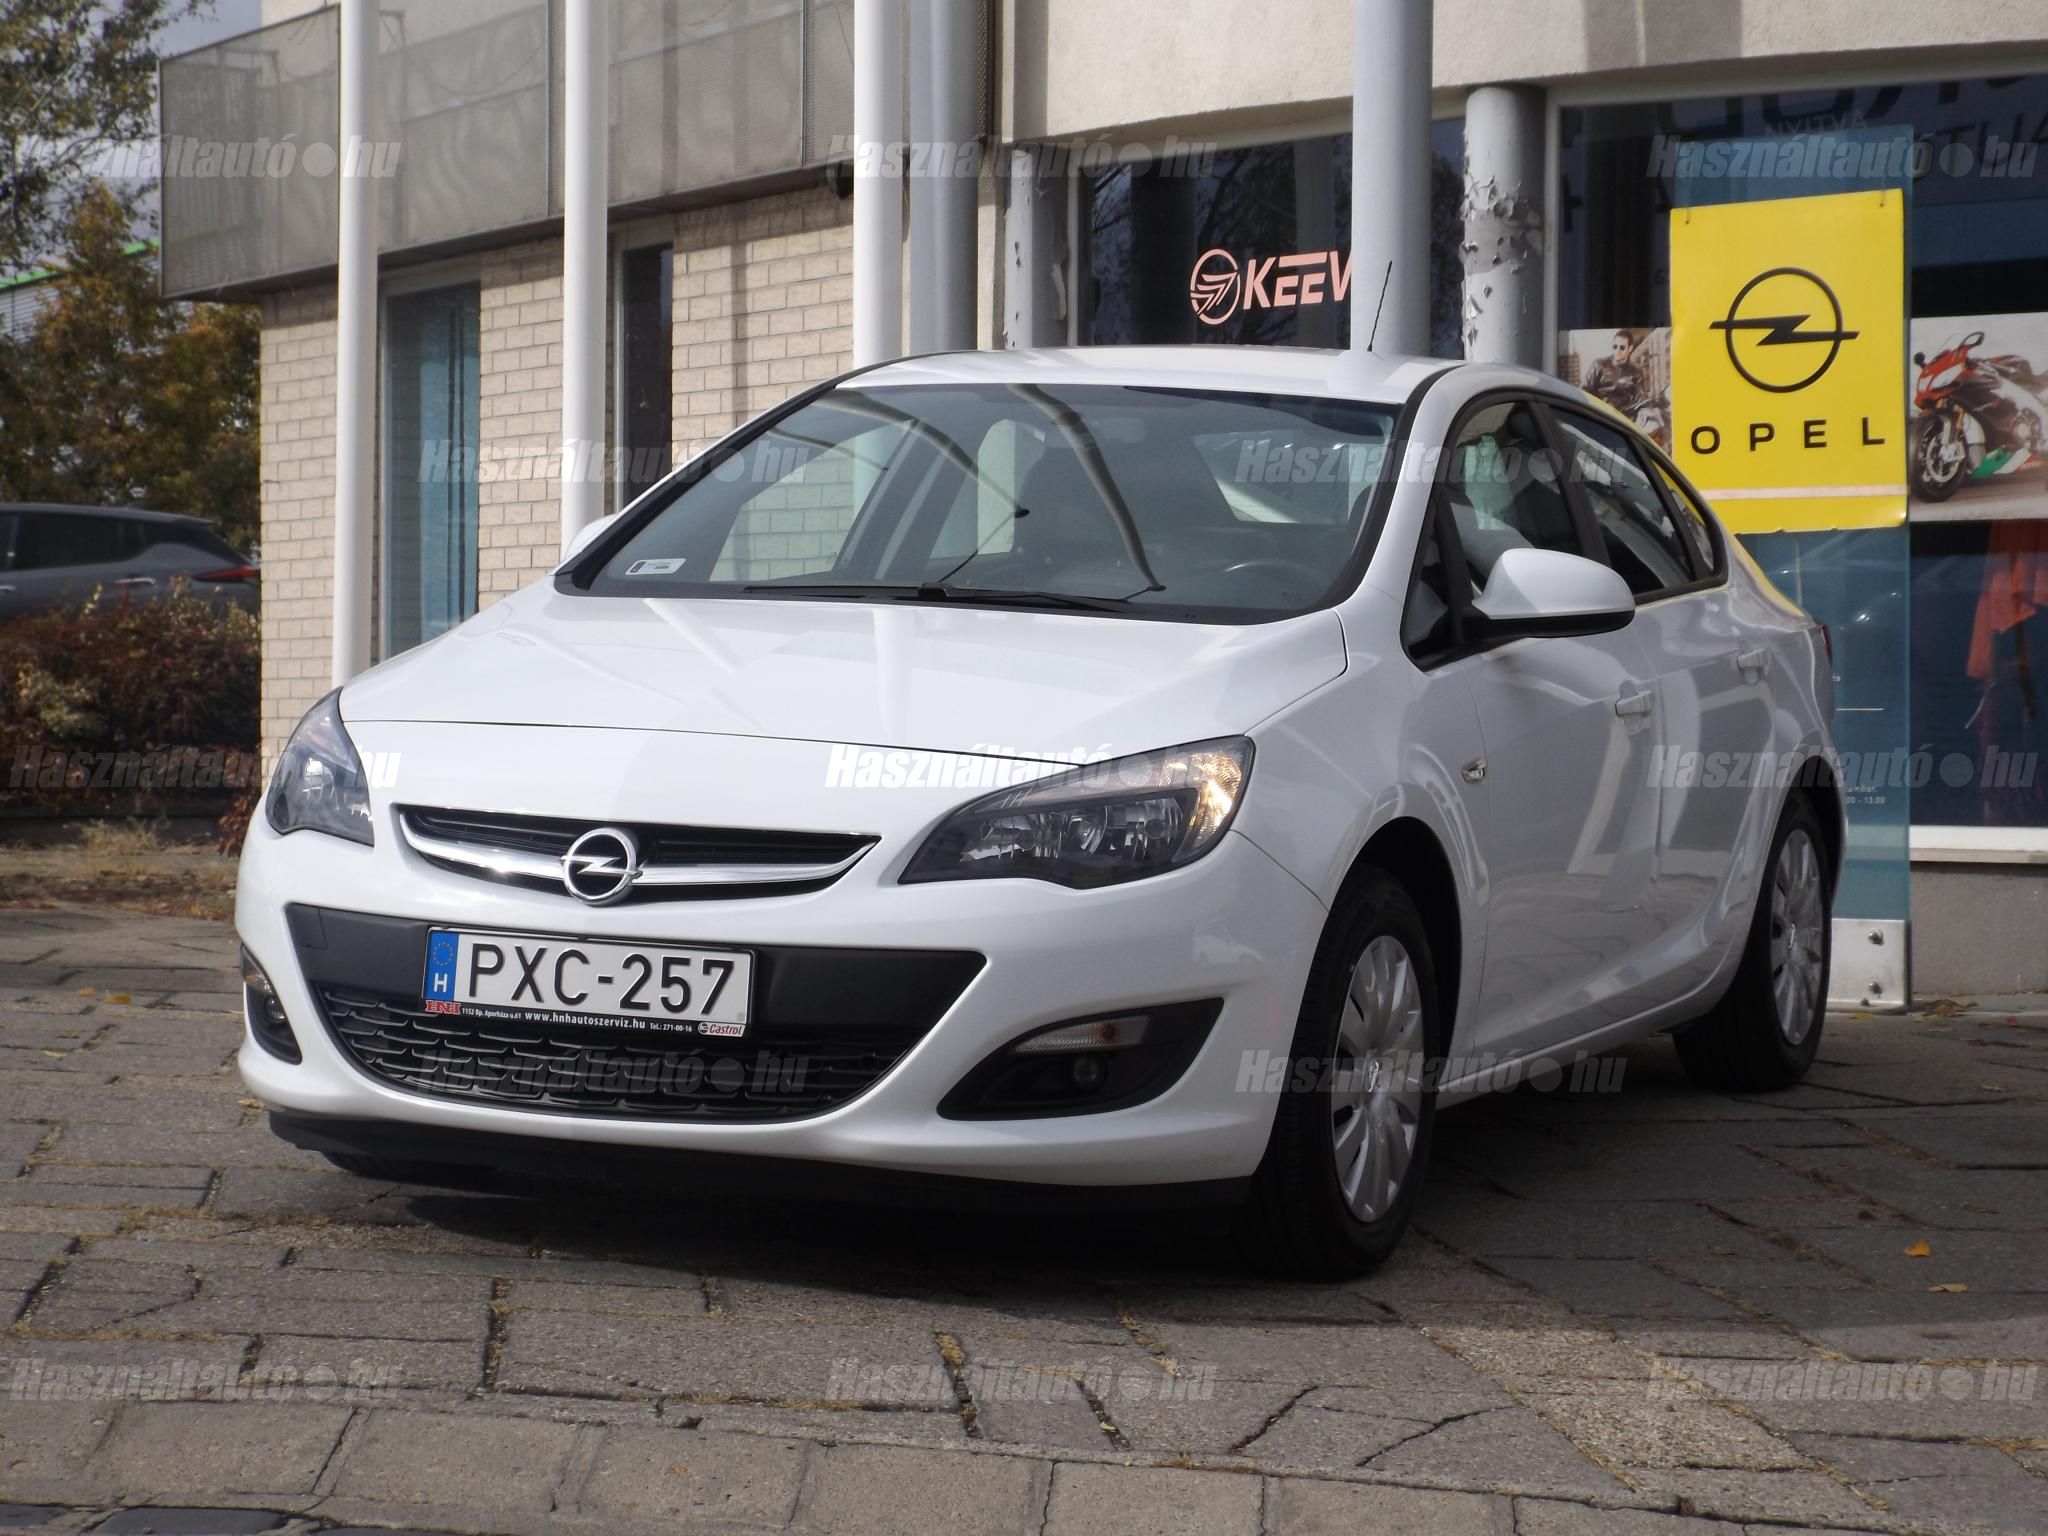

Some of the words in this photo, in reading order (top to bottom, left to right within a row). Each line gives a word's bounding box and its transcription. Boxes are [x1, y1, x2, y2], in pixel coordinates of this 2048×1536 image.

[1690, 416, 1886, 455] OPEL
[433, 972, 448, 993] H
[469, 943, 735, 1015] PXC-257
[524, 1011, 646, 1029] www.hnhautoszerviz.hu
[709, 1023, 743, 1035] Castrol
